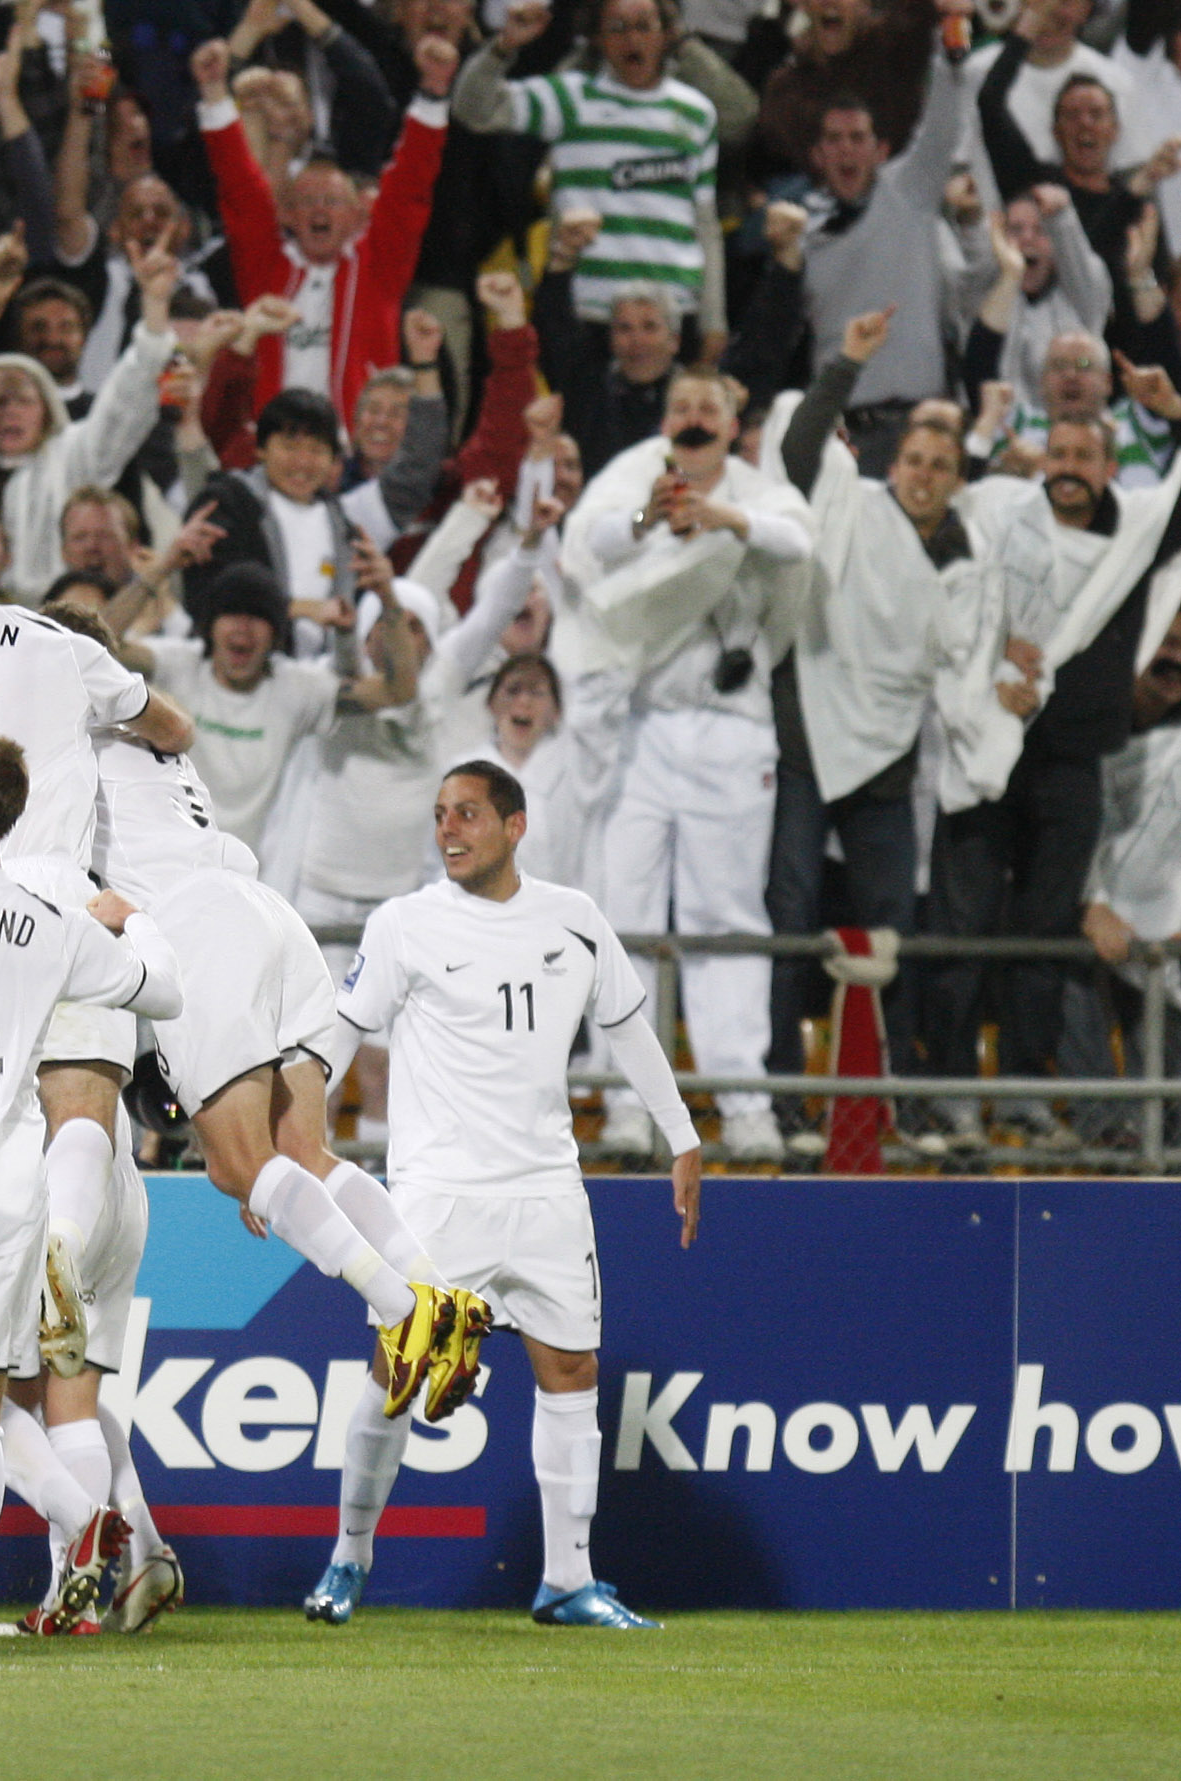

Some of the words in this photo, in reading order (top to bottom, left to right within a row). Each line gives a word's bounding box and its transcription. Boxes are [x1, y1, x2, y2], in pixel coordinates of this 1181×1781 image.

[498, 982, 535, 1031] 11
[615, 1371, 976, 1473] Know
[1004, 1364, 1181, 1473] ho
